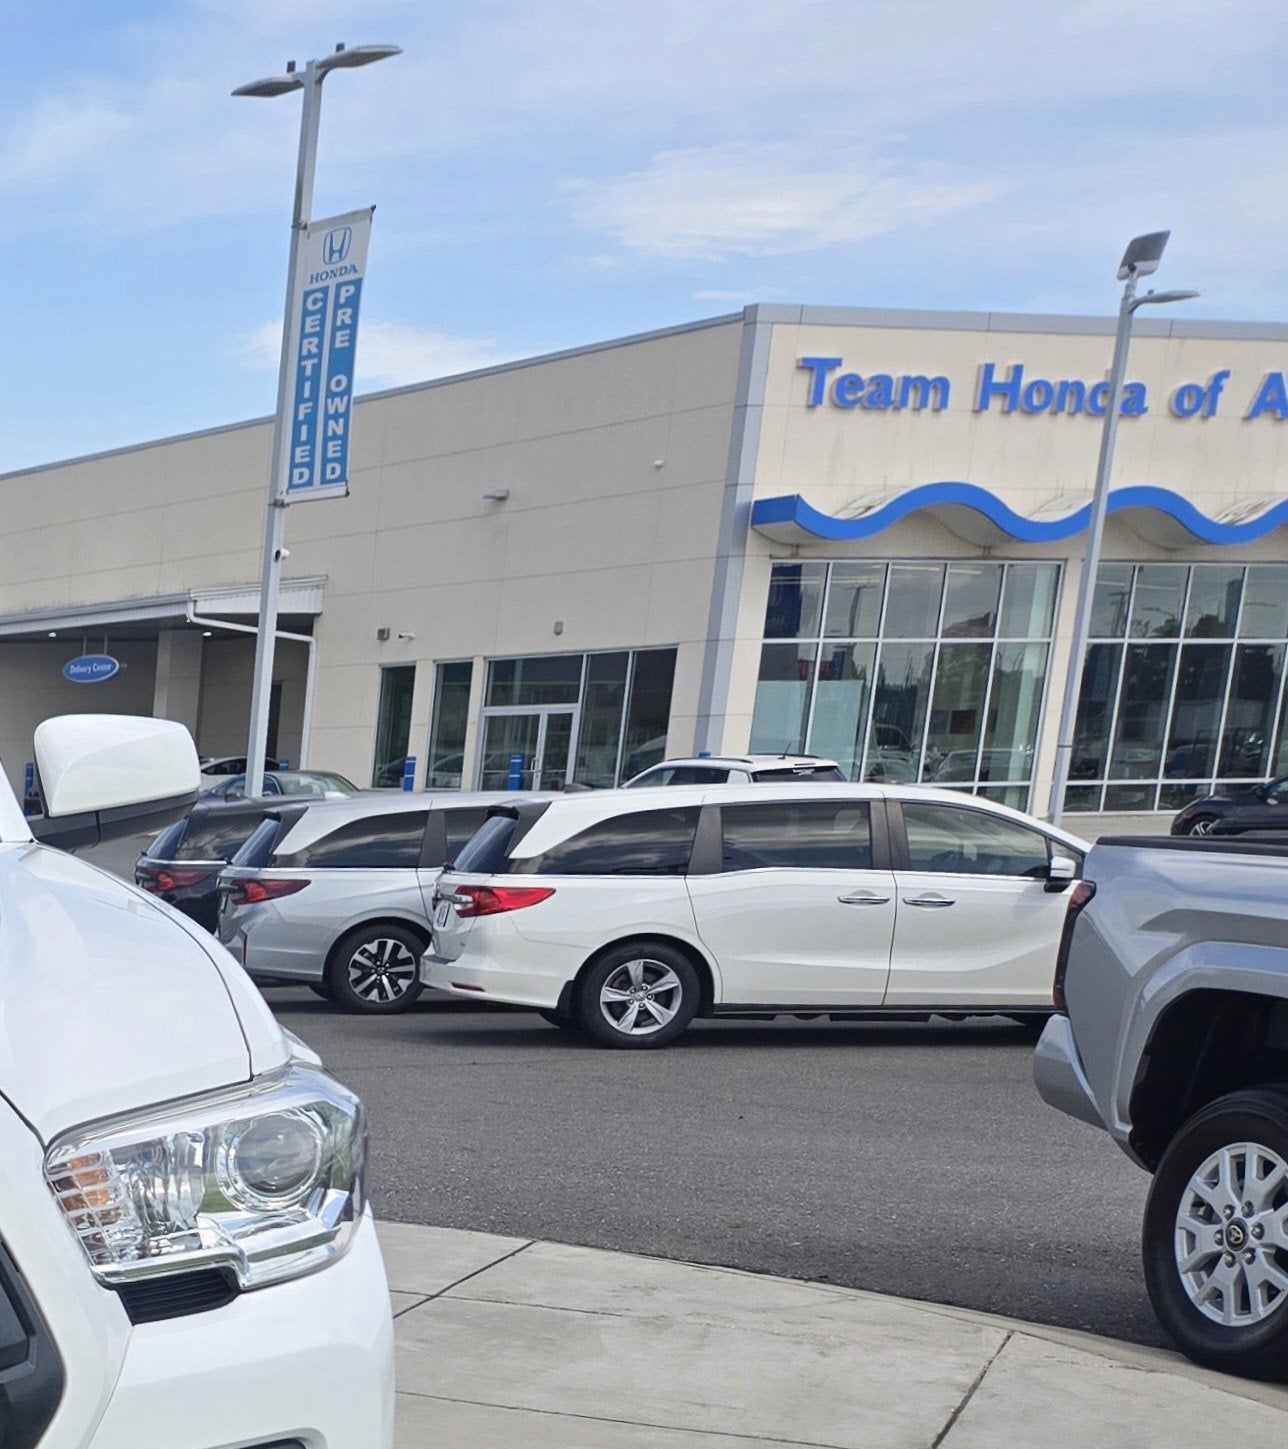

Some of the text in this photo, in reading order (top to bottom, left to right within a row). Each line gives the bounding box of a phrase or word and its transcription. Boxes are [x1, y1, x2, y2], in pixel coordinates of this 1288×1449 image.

[309, 263, 359, 285] HONDA
[292, 291, 325, 487] CERTIFIED
[325, 284, 356, 482] PRE OWNED
[798, 356, 951, 411] Team
[1172, 369, 1231, 418] of
